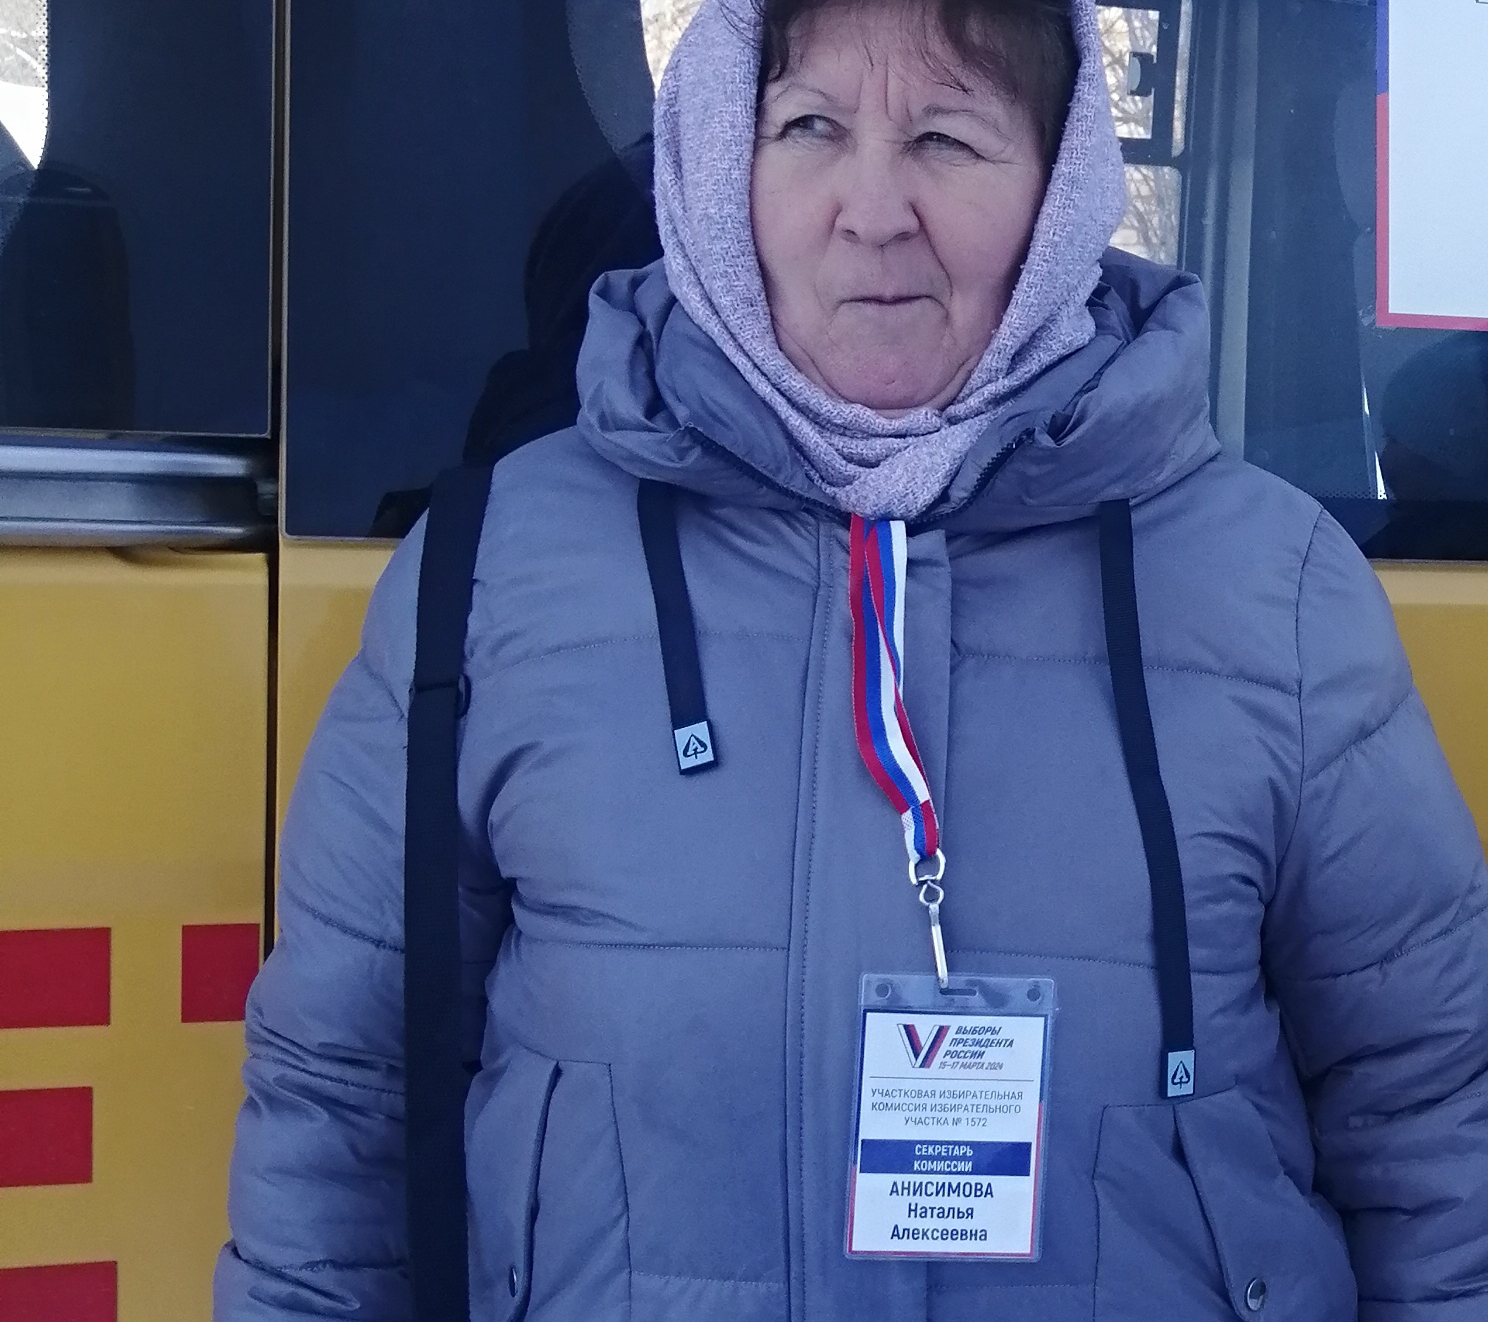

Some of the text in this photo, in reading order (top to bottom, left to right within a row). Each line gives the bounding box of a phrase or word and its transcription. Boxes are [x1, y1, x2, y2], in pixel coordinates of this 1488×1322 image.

[955, 1025, 1002, 1036] ВЫБОРЫ
[949, 1037, 1014, 1049] ПРЕЗИДЕНТА
[943, 1049, 985, 1060] РОССИИ
[959, 1061, 986, 1071] МАРТА
[871, 1088, 1023, 1101] УЧАСТКОВАЯ ИЗБИРАТЕЛЬНАЯ
[871, 1102, 1021, 1114] КОМИССИЯ ИЗБИРАТЕЛЬНОГО
[904, 1116, 949, 1127] УЧАСТКА
[965, 1117, 987, 1127] 1572
[915, 1144, 973, 1156] СЕКРЕТАРЬ
[913, 1160, 973, 1172] КОМИССИИ
[889, 1181, 994, 1198] АНИСИМОВА
[907, 1203, 974, 1220] Наталья
[890, 1224, 988, 1241] Алексеевна
